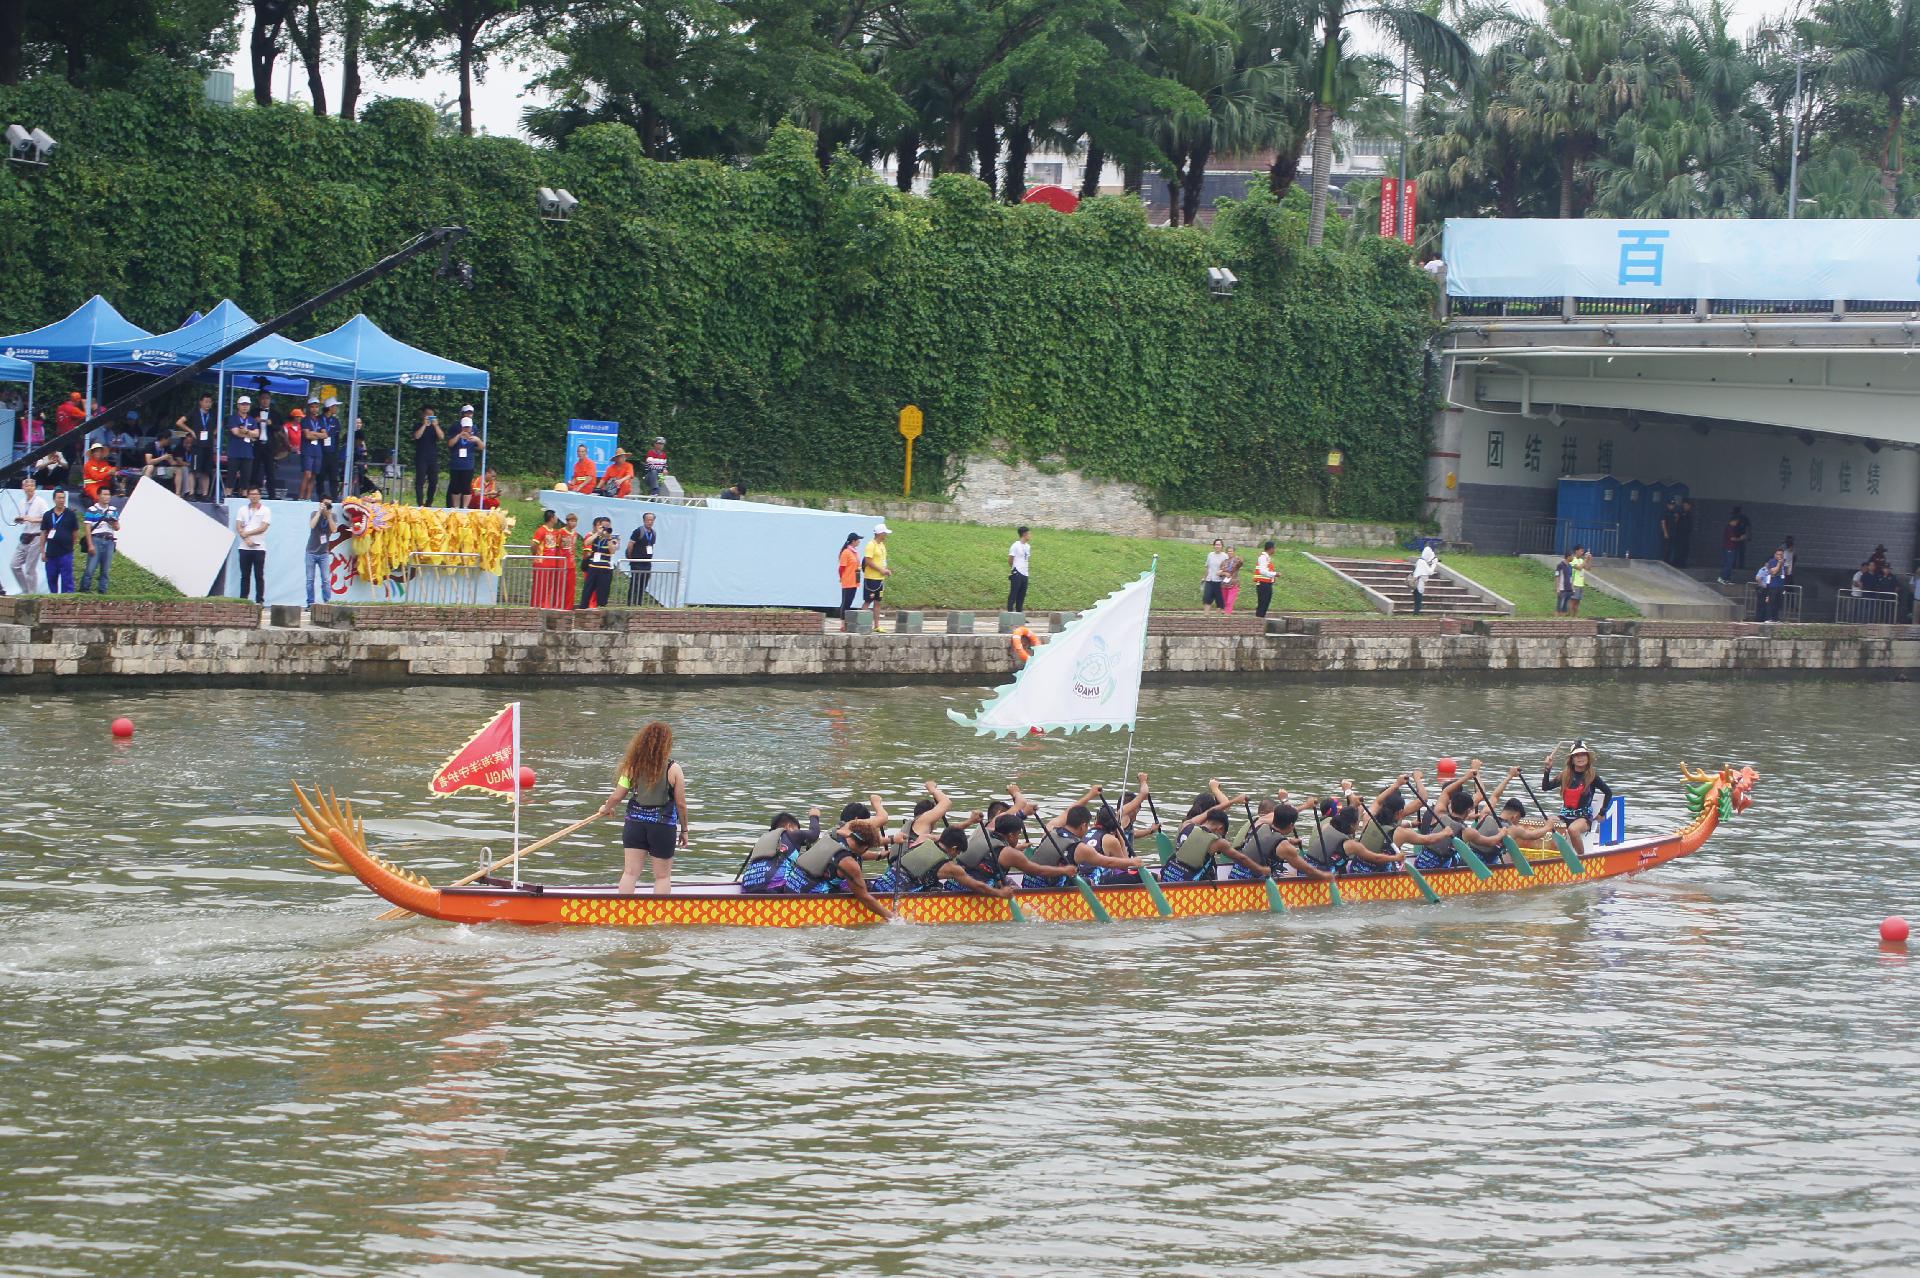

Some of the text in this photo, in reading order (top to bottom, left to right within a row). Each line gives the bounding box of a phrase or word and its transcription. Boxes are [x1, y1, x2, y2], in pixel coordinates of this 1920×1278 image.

[1617, 229, 1670, 287] 百
[1487, 430, 1614, 474] 团结拼搏
[1779, 455, 1881, 496] 争创佳绩
[1605, 799, 1619, 842] 1
